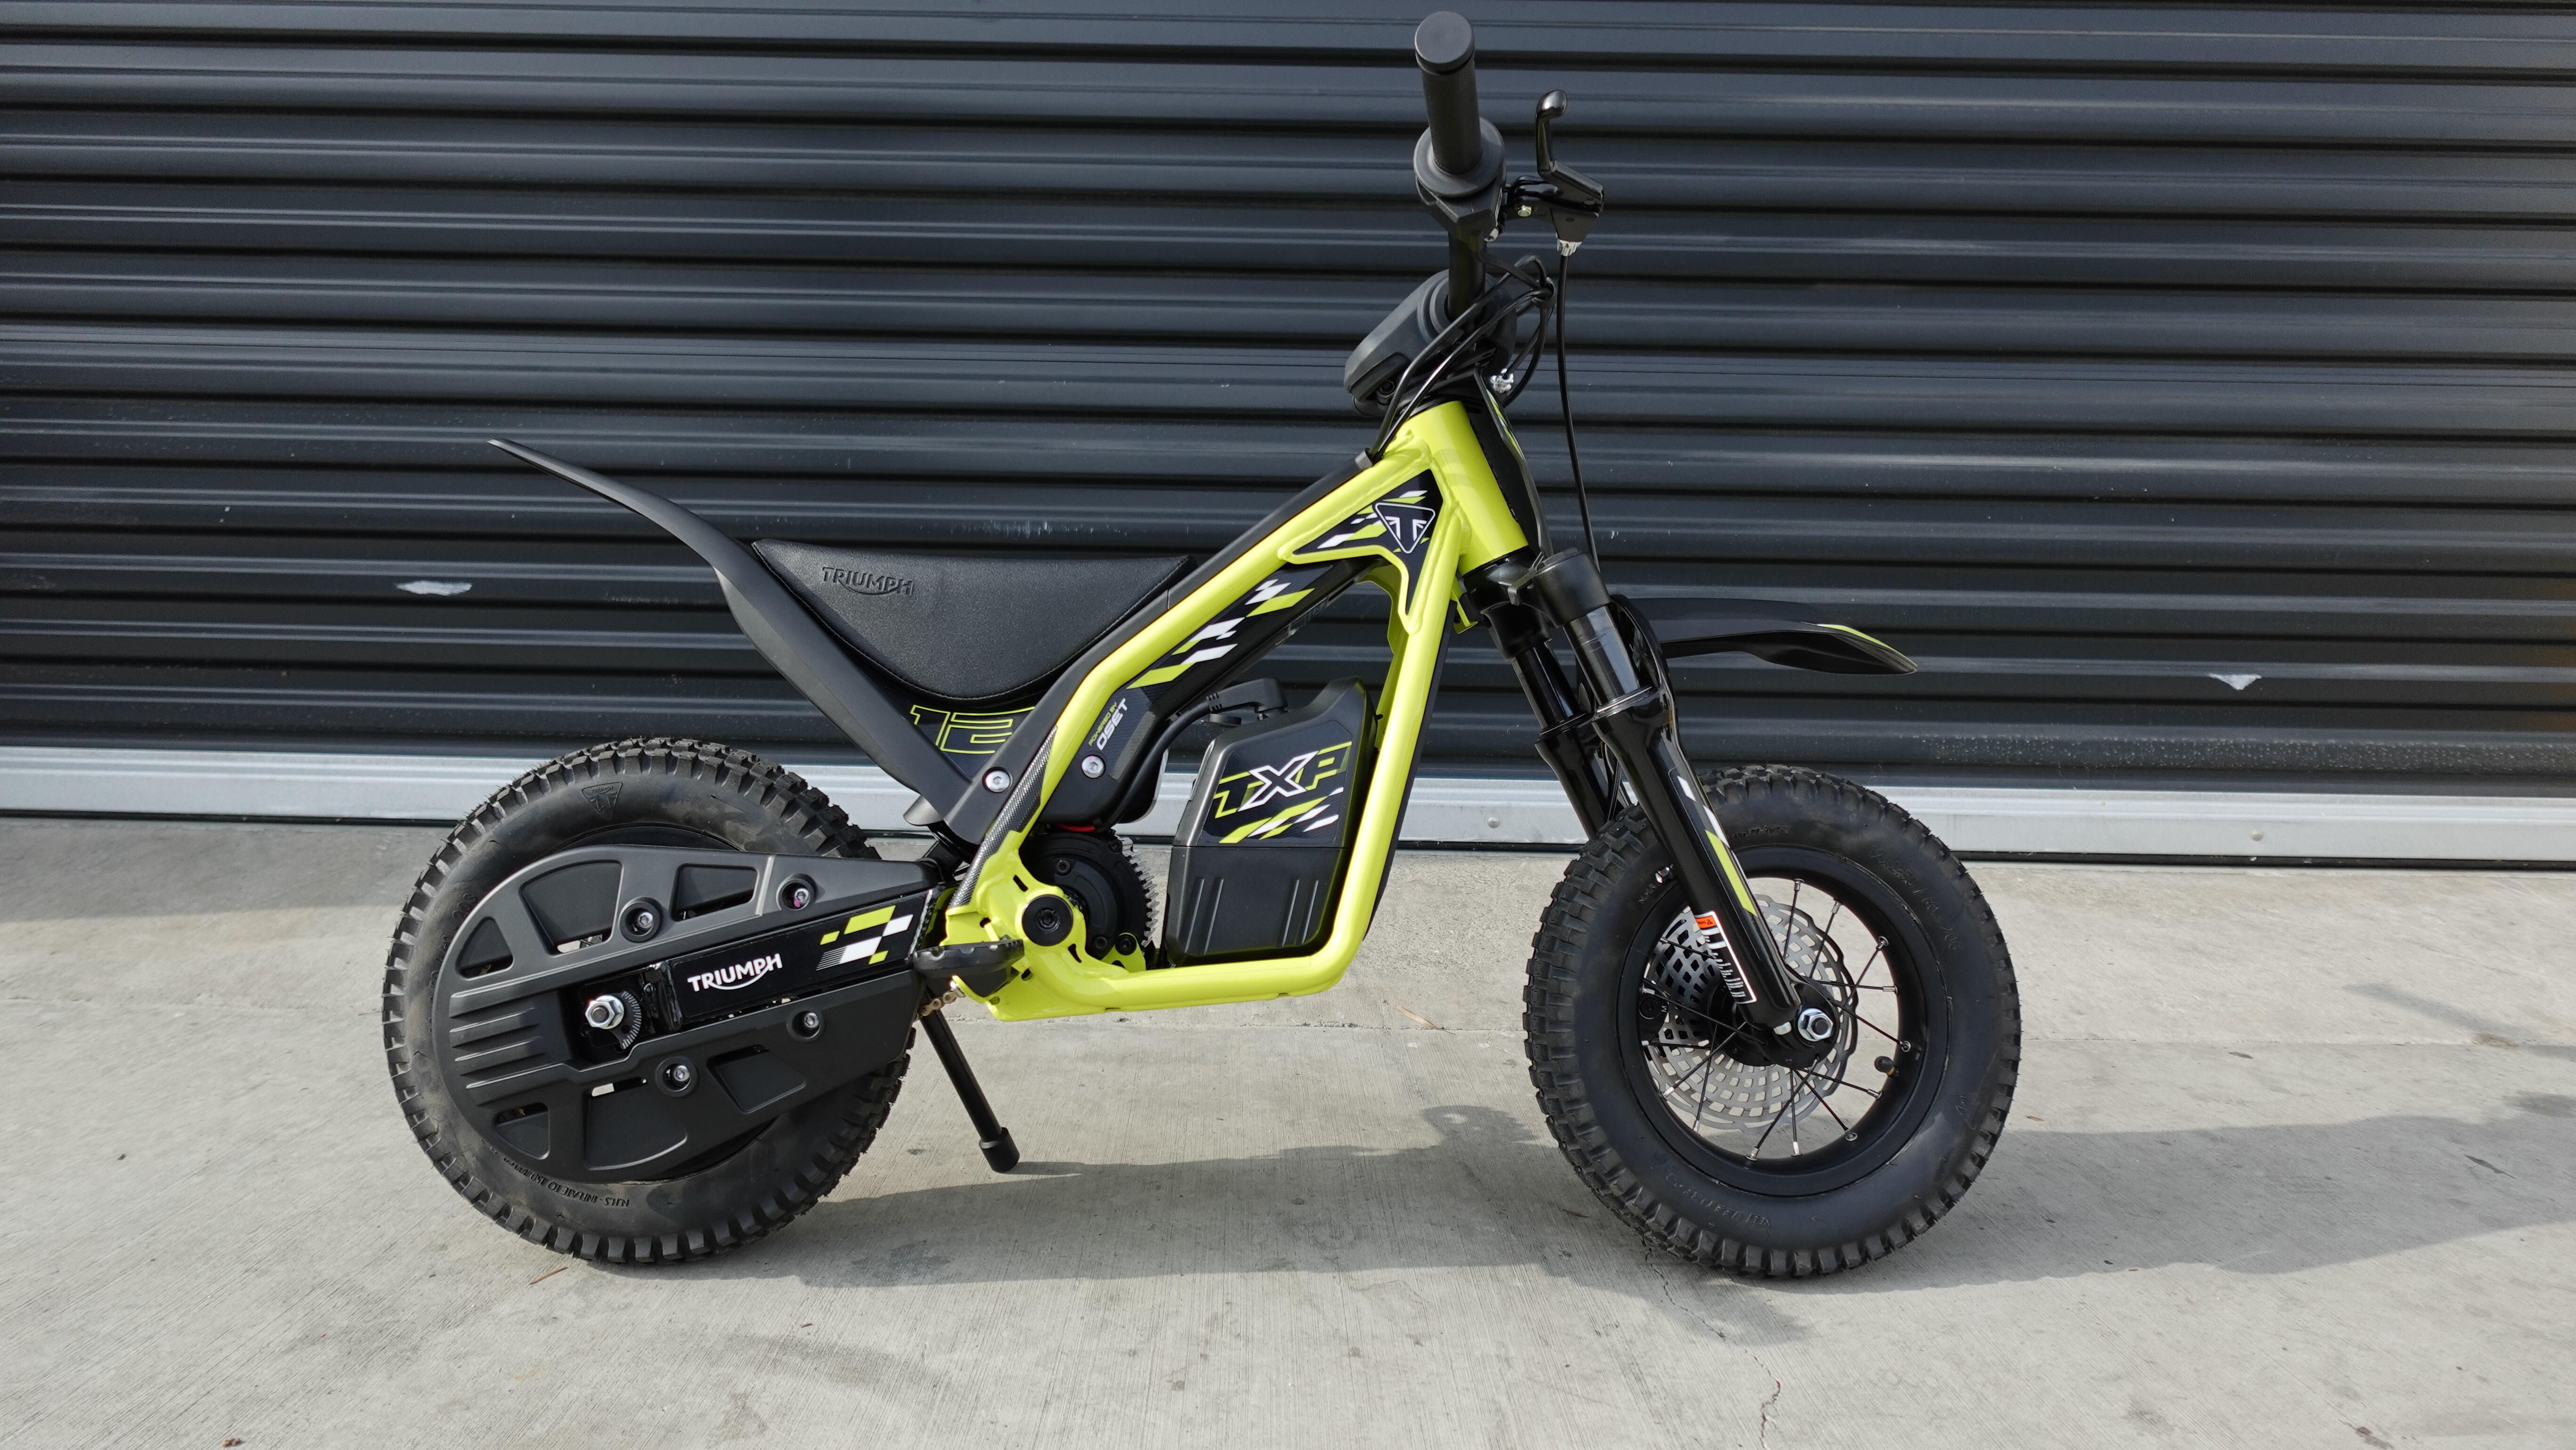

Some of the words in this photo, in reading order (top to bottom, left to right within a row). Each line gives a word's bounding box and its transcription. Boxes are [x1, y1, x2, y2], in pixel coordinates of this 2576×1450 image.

[822, 566, 914, 596] TRIUMPH
[1088, 712, 1111, 746] POWERED
[1109, 701, 1117, 713] BY
[1096, 698, 1128, 750] OSET
[1213, 741, 1352, 819] TXP
[687, 952, 783, 991] TRIUMPH
